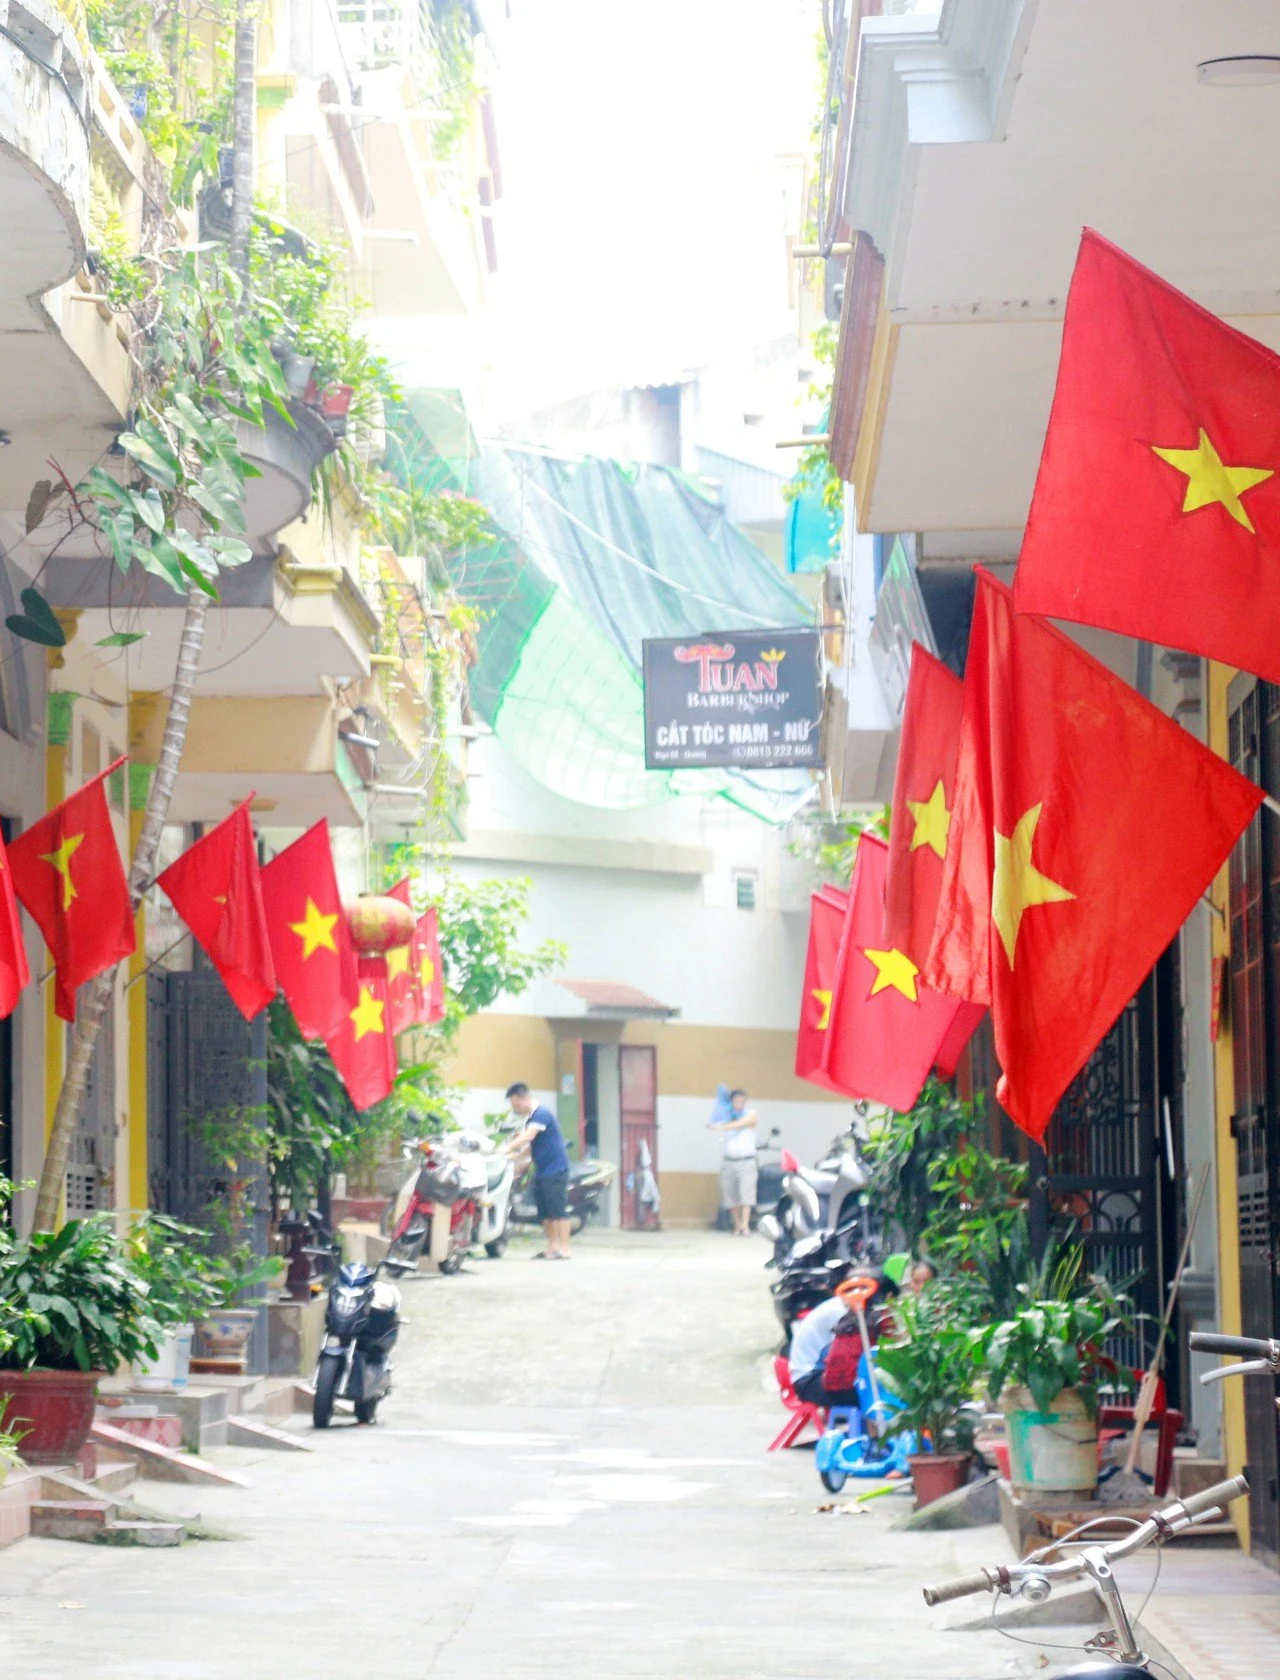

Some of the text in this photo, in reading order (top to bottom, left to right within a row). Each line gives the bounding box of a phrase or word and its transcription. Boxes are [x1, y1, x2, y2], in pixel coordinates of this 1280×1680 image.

[692, 721, 725, 746] TÓC
[729, 723, 769, 744] NAM
[774, 744, 793, 756] 222
